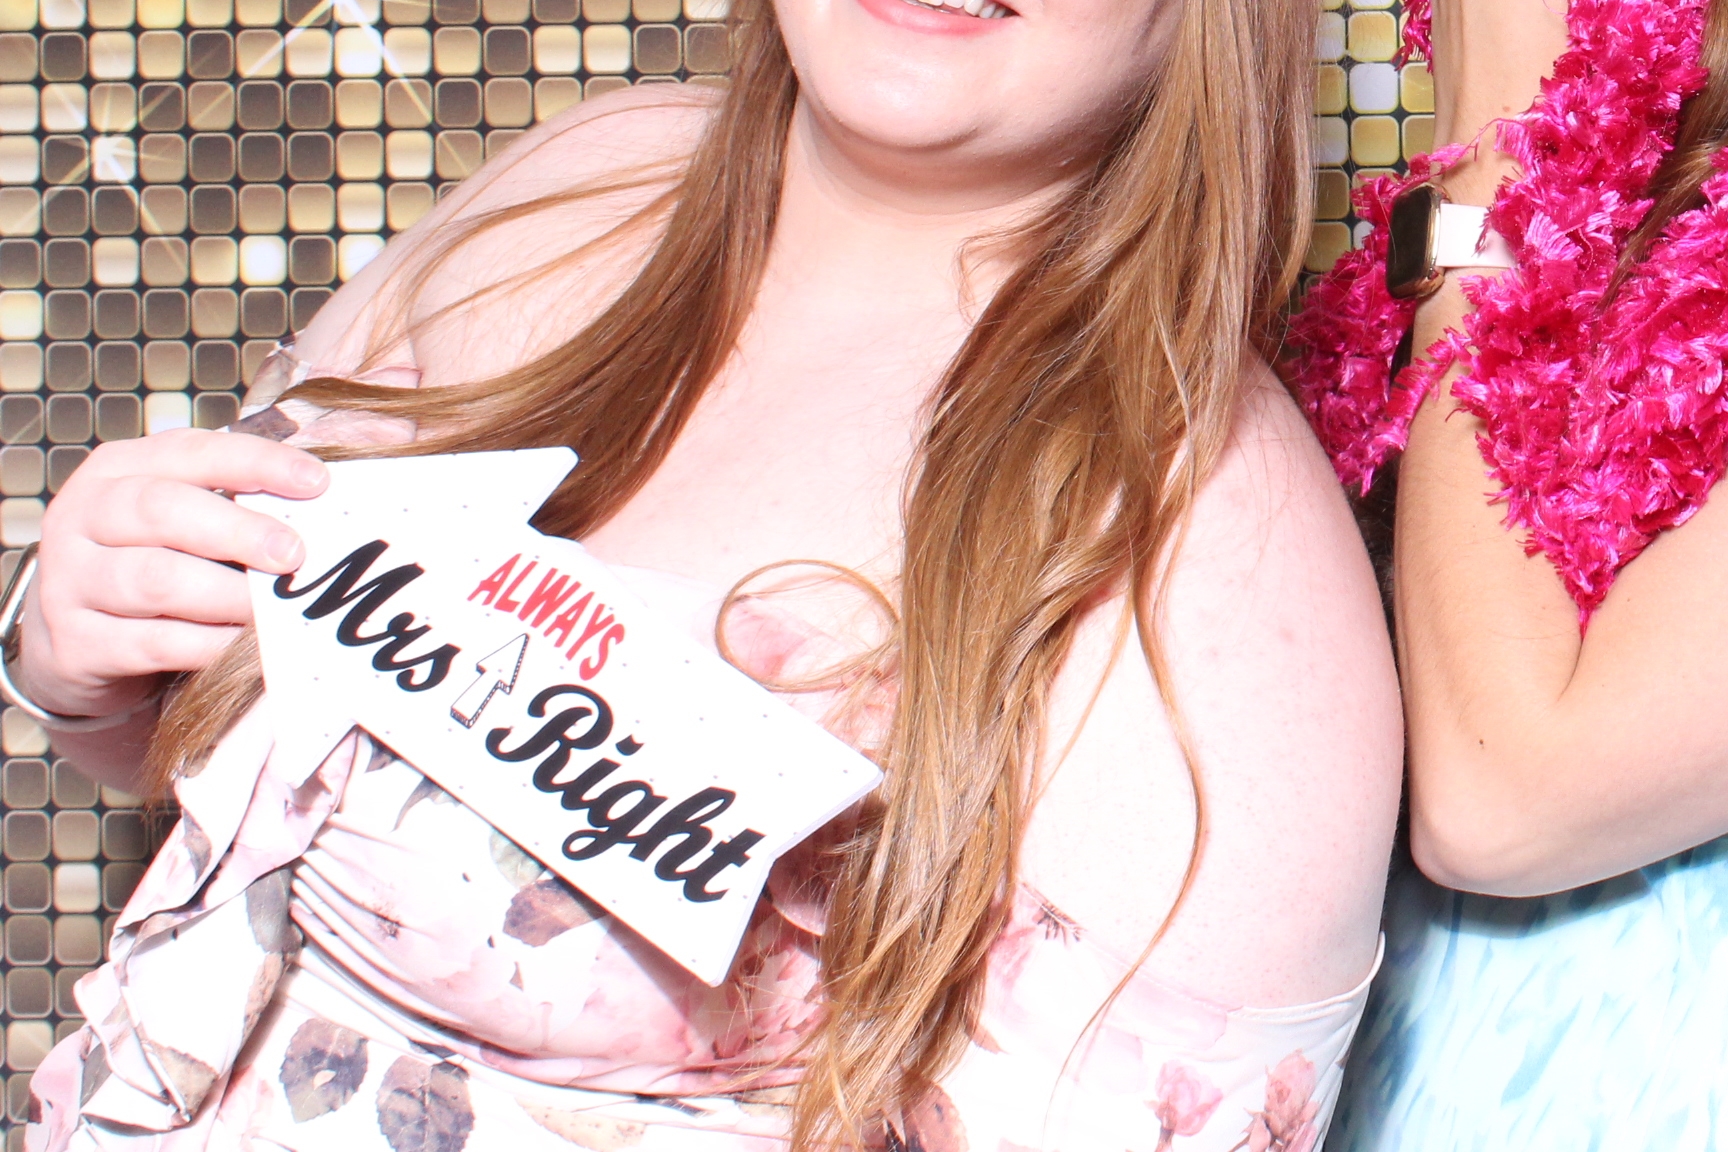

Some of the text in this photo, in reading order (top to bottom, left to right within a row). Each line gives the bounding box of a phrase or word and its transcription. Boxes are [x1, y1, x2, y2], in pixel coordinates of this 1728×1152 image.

[272, 539, 767, 904] Mrs Right
[467, 552, 626, 681] ALWAYS
